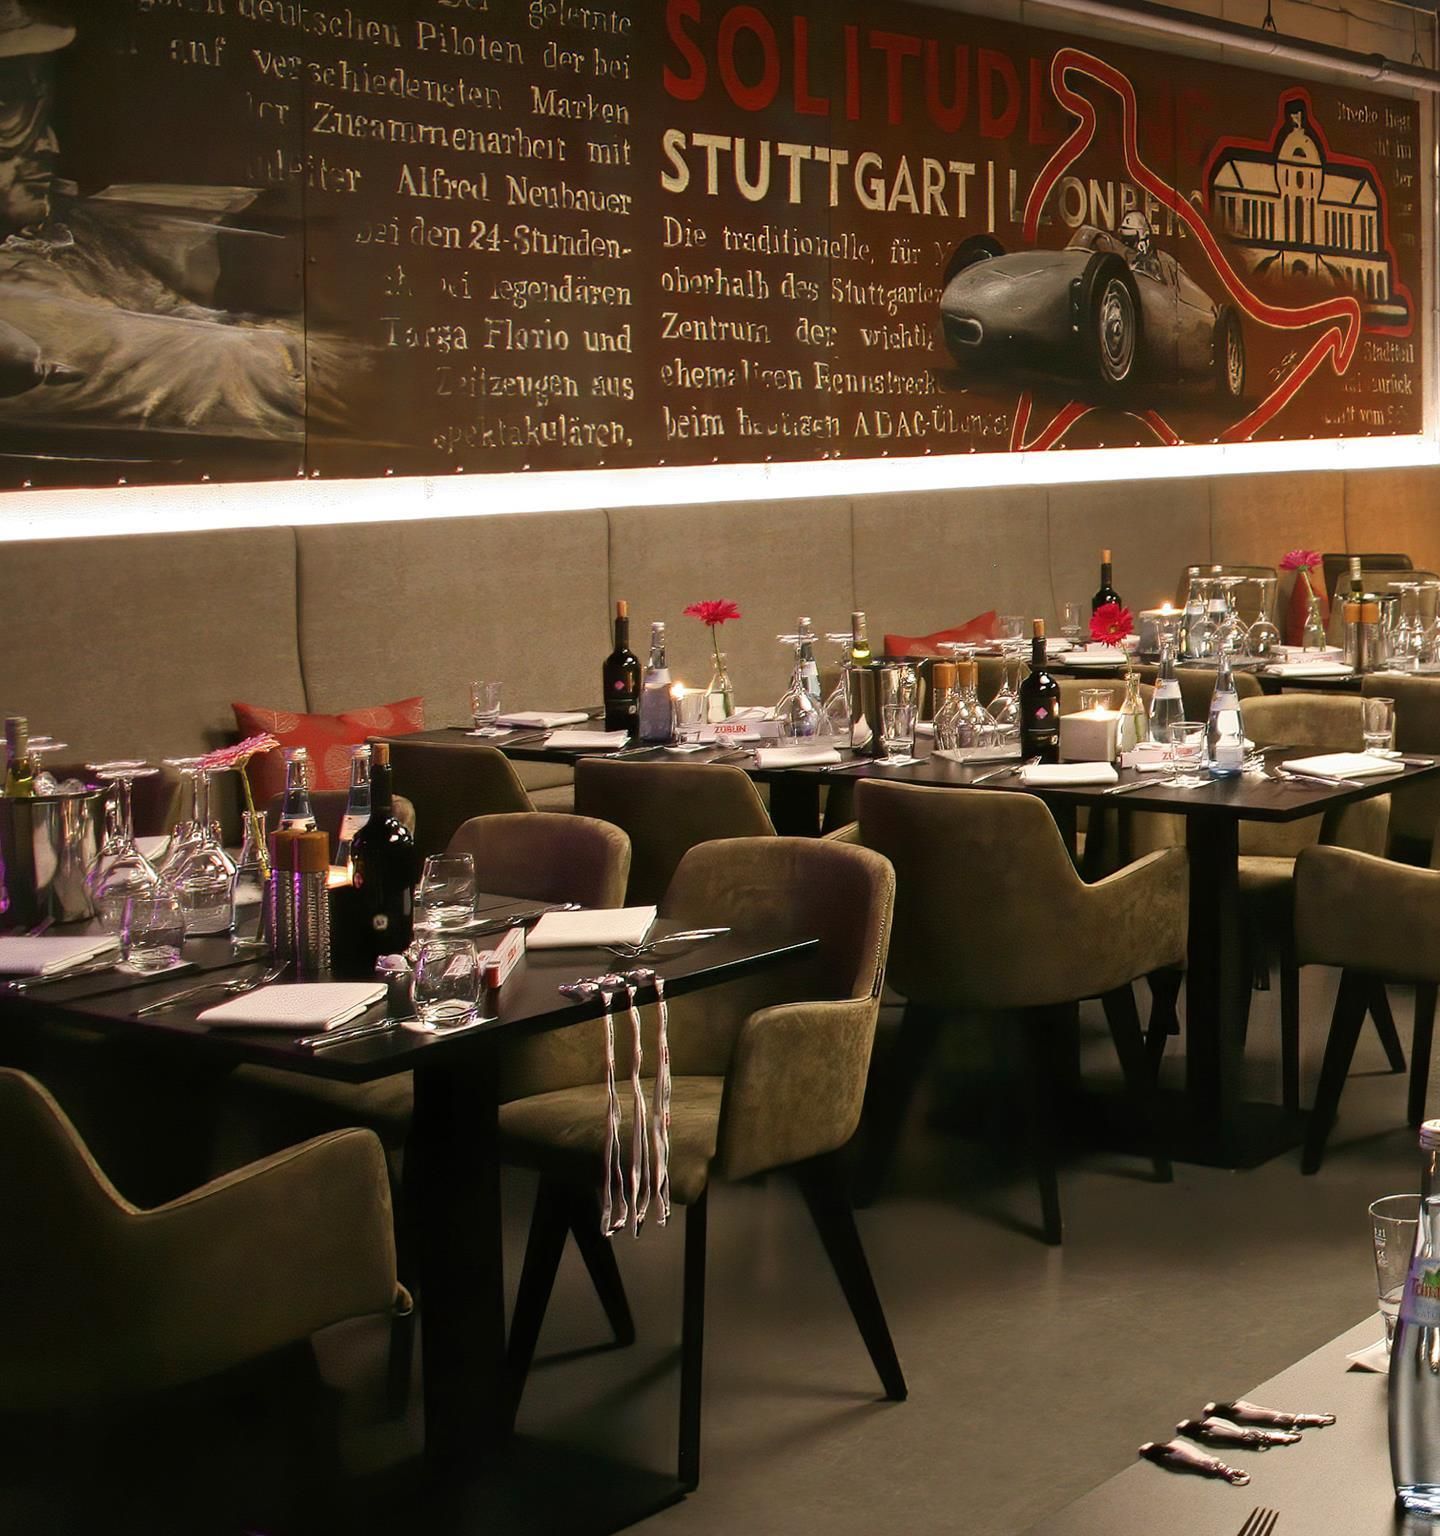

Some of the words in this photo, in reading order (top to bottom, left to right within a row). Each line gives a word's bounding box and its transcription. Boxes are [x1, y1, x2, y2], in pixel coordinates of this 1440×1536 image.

[414, 19, 525, 66] Piloten
[543, 39, 586, 75] der
[592, 47, 632, 81] bei
[529, 84, 631, 126] Marken
[584, 137, 632, 167] mit
[396, 162, 491, 203] Alfred
[505, 173, 632, 215] Neubauer
[661, 128, 976, 218] STUTTGART
[410, 216, 462, 250] den
[467, 219, 633, 260] 24-Stunden-
[662, 215, 707, 248] Die
[889, 239, 921, 265] für
[660, 265, 771, 300] oberhalb
[780, 271, 820, 301] des
[483, 316, 570, 352] Florio
[583, 323, 633, 353] und
[660, 311, 771, 344] Zentrum
[592, 375, 635, 401] aus
[661, 404, 726, 441] beim
